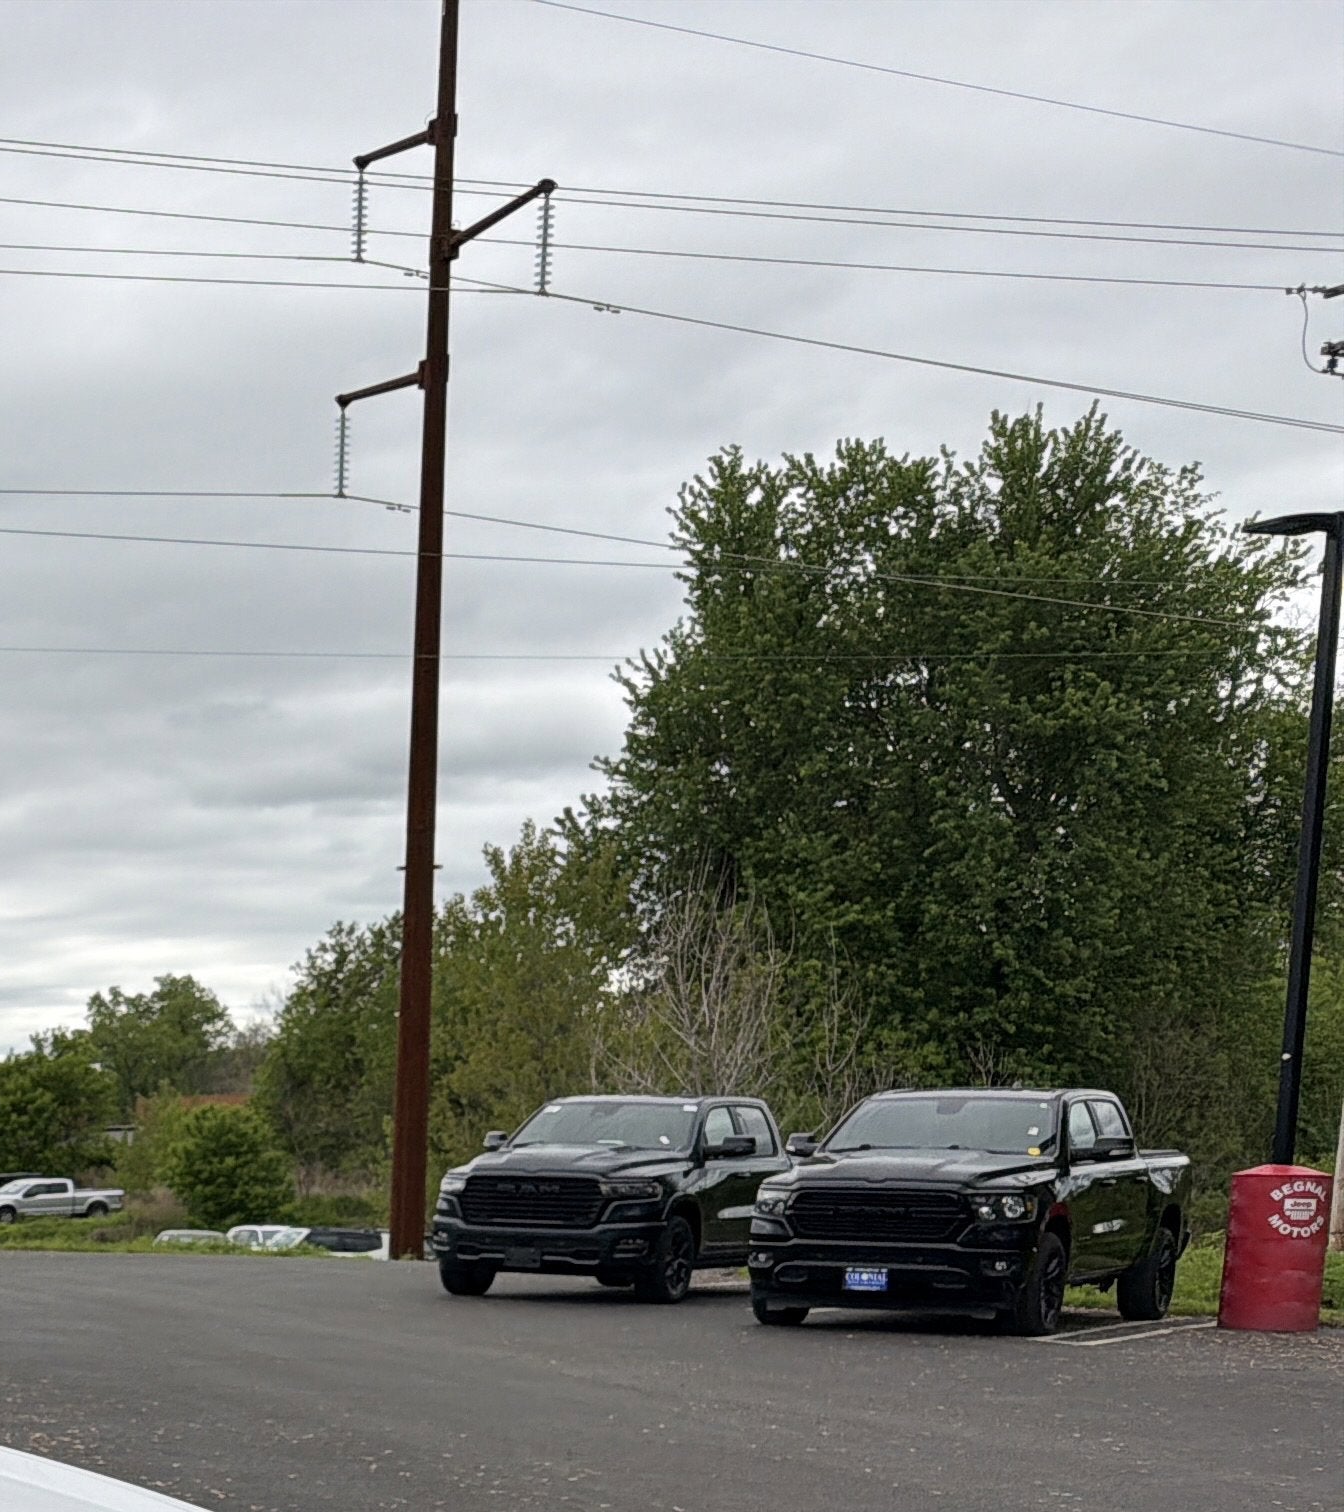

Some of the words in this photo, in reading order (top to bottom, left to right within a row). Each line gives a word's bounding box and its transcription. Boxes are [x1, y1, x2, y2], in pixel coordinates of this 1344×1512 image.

[1269, 1180, 1326, 1202] BEGNAL
[1290, 1200, 1313, 1208] Jeep
[1267, 1213, 1324, 1238] MOTORS
